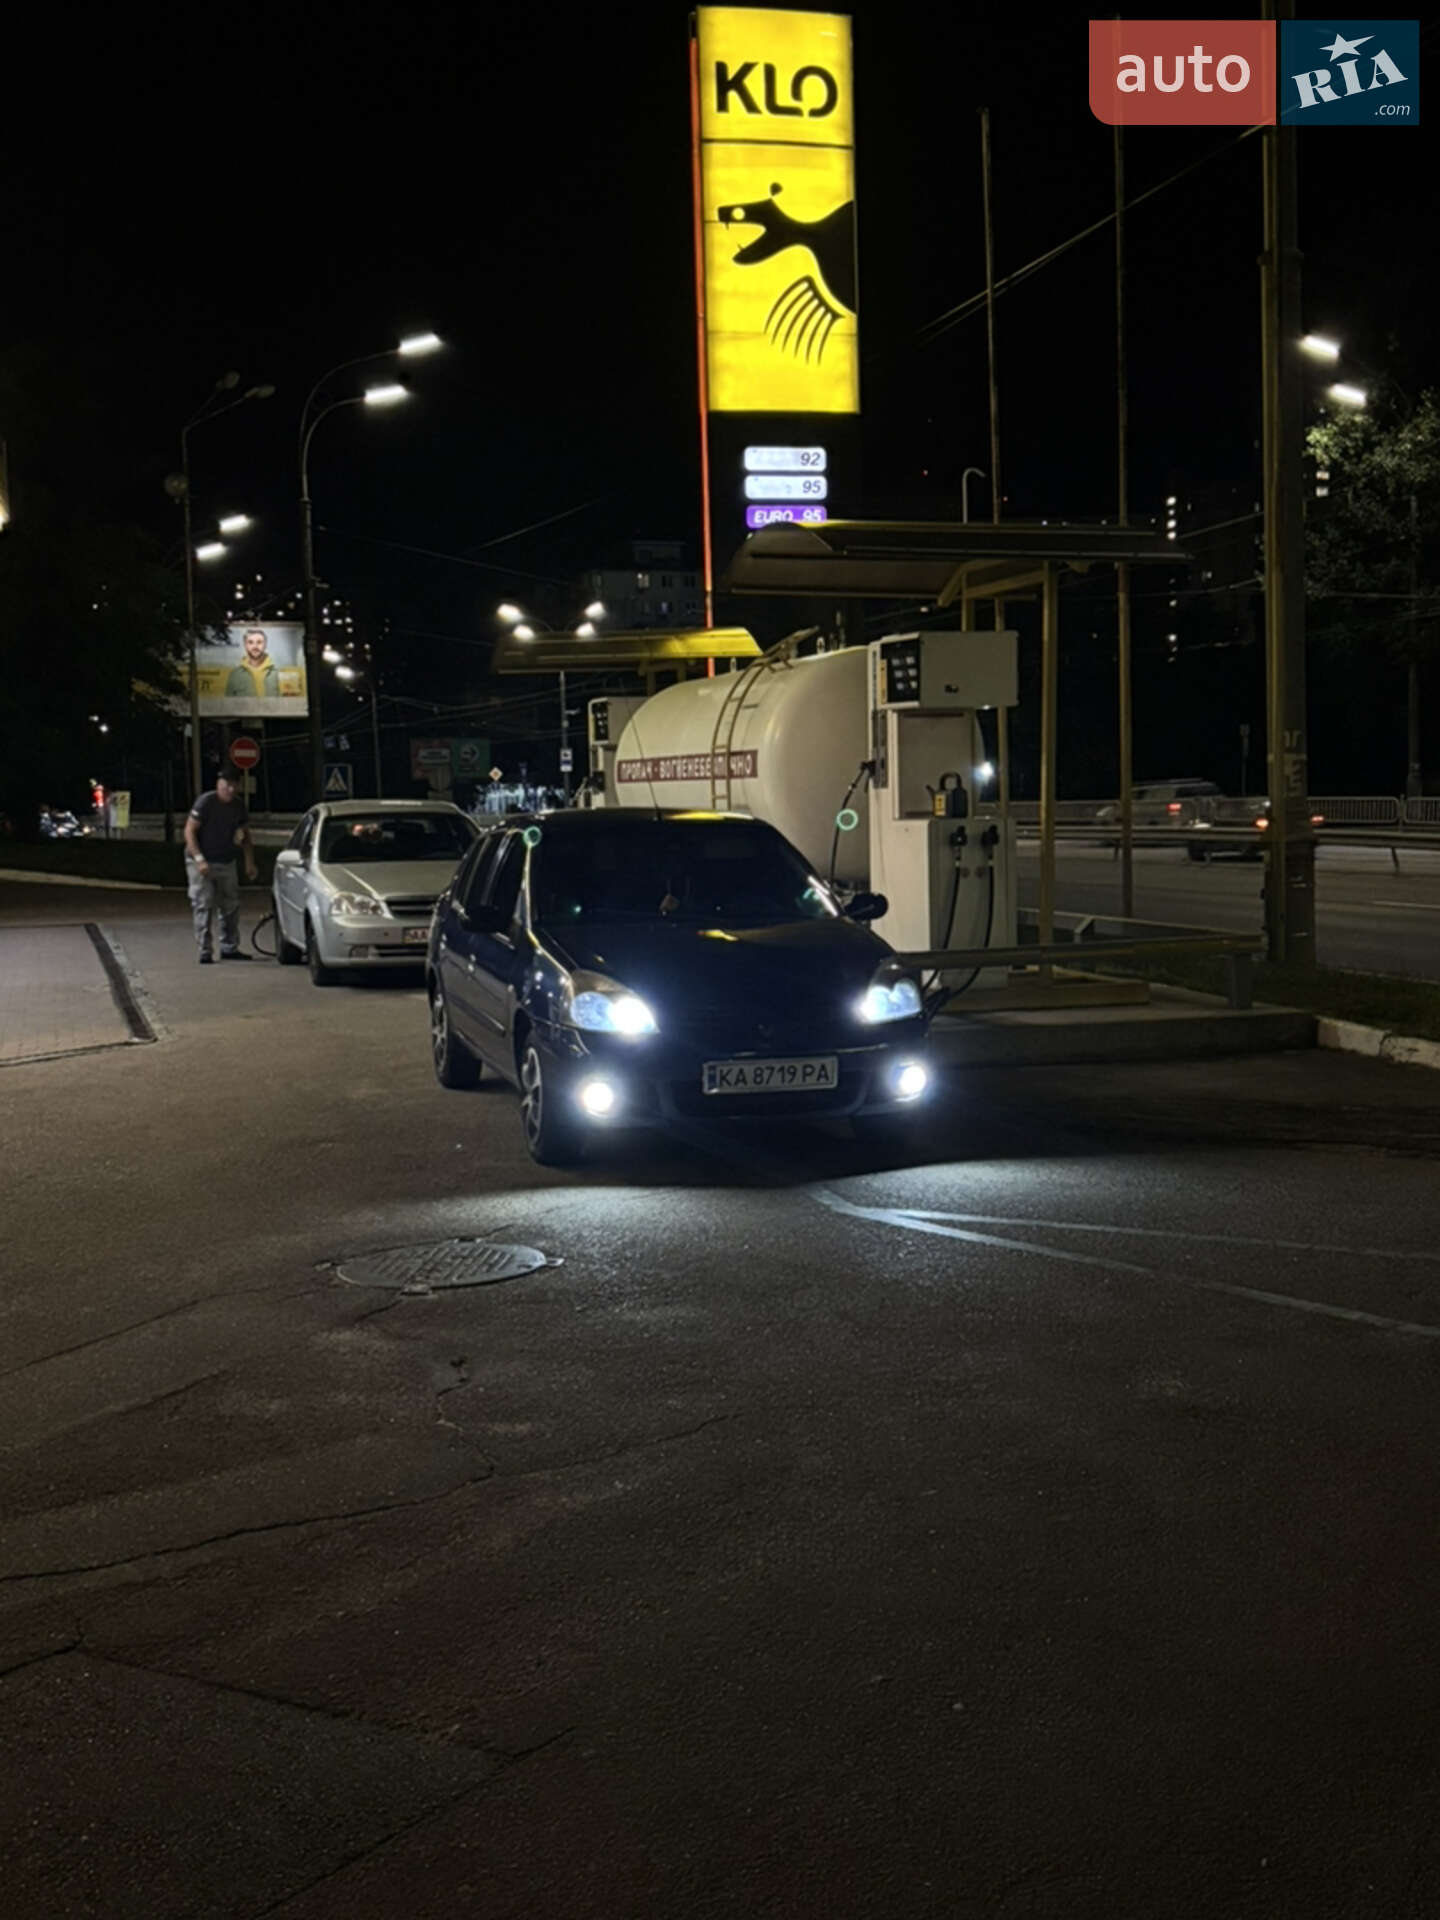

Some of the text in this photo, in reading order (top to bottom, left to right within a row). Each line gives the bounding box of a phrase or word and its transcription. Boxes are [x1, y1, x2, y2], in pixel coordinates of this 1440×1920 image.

[715, 60, 838, 117] KLO
[800, 452, 821, 466] 92
[802, 480, 821, 494] 95
[754, 509, 822, 524] EURO 95
[719, 1063, 830, 1087] KA 8719 PA
